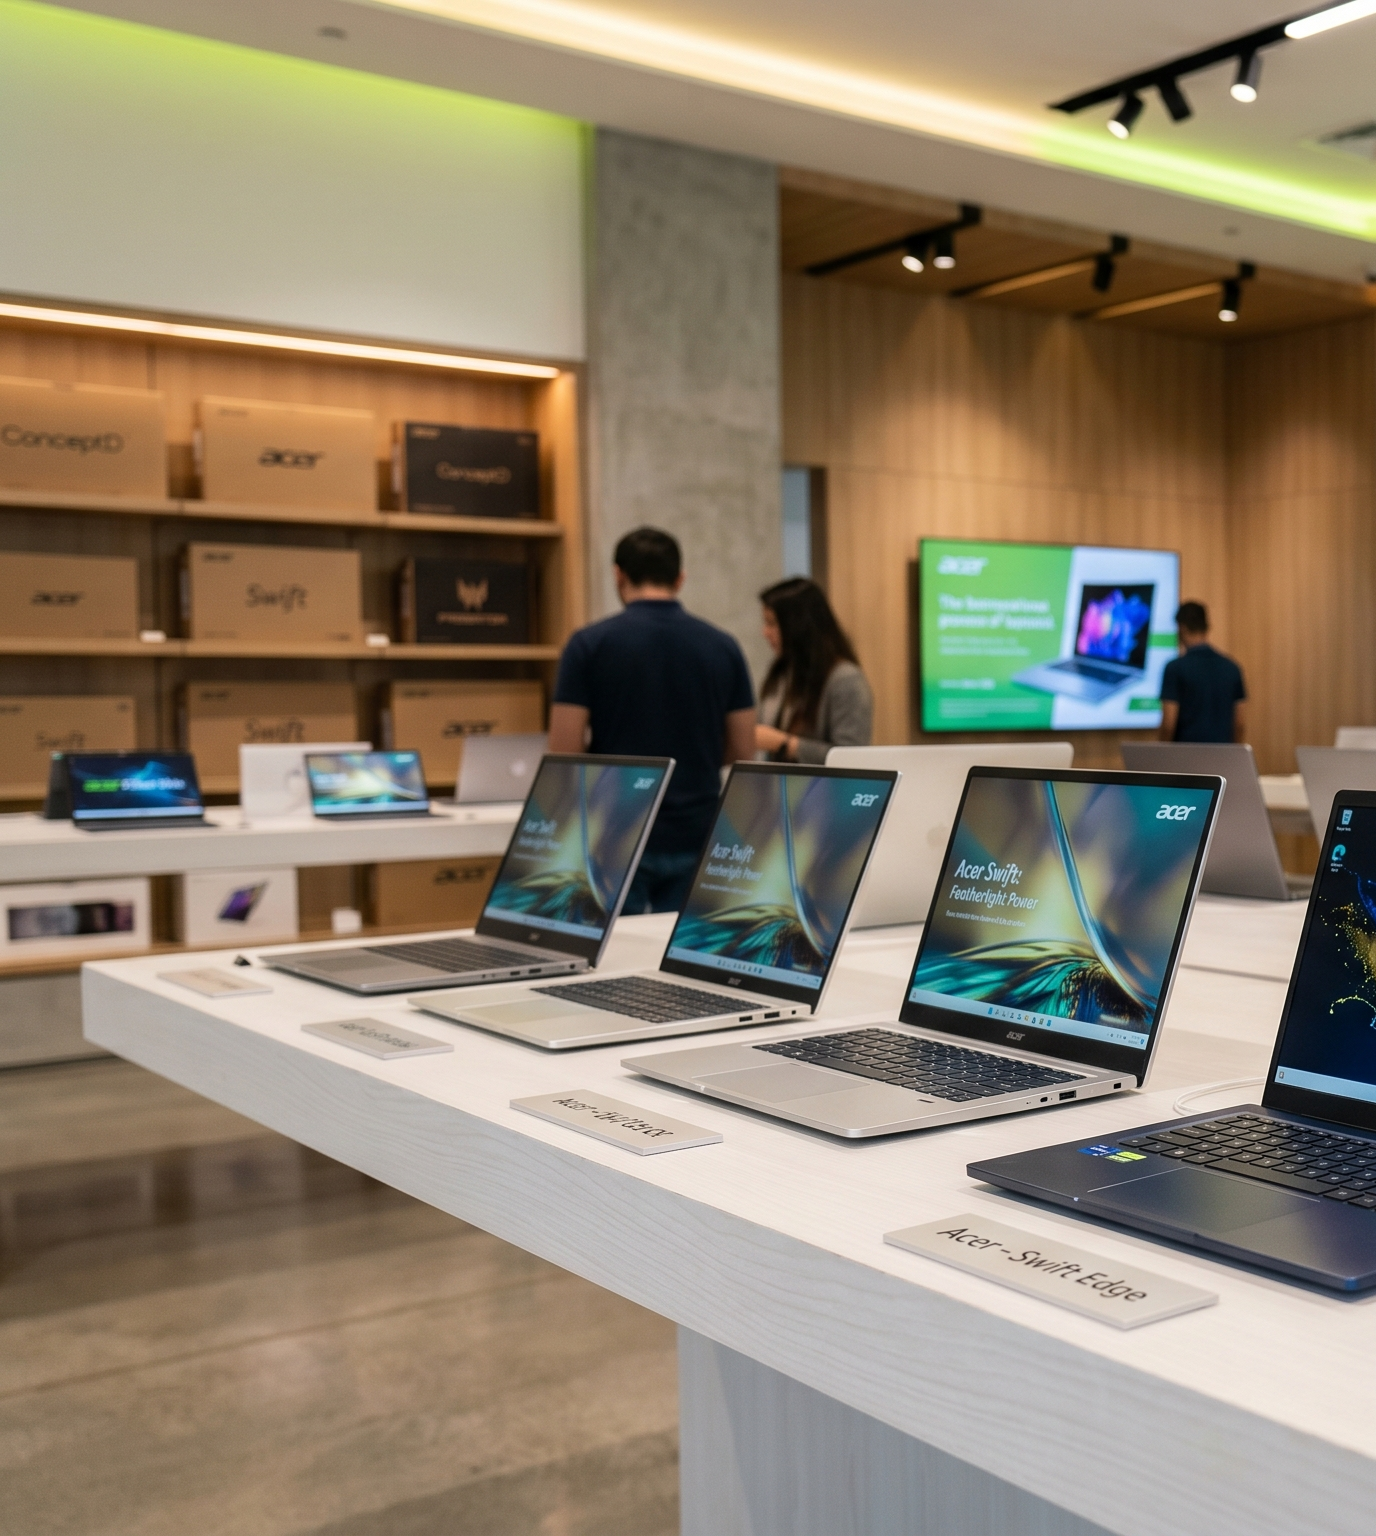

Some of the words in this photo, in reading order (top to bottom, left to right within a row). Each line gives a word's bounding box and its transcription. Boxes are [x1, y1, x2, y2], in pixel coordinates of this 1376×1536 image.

[257, 447, 325, 471] acer
[850, 793, 880, 807] acer
[1155, 804, 1197, 821] acer
[954, 859, 985, 880] Acer
[949, 885, 1007, 908] Featherlight
[936, 1227, 1003, 1252] Acer
[1008, 1250, 1083, 1279] Swift
[1075, 1271, 1148, 1303] Edge
